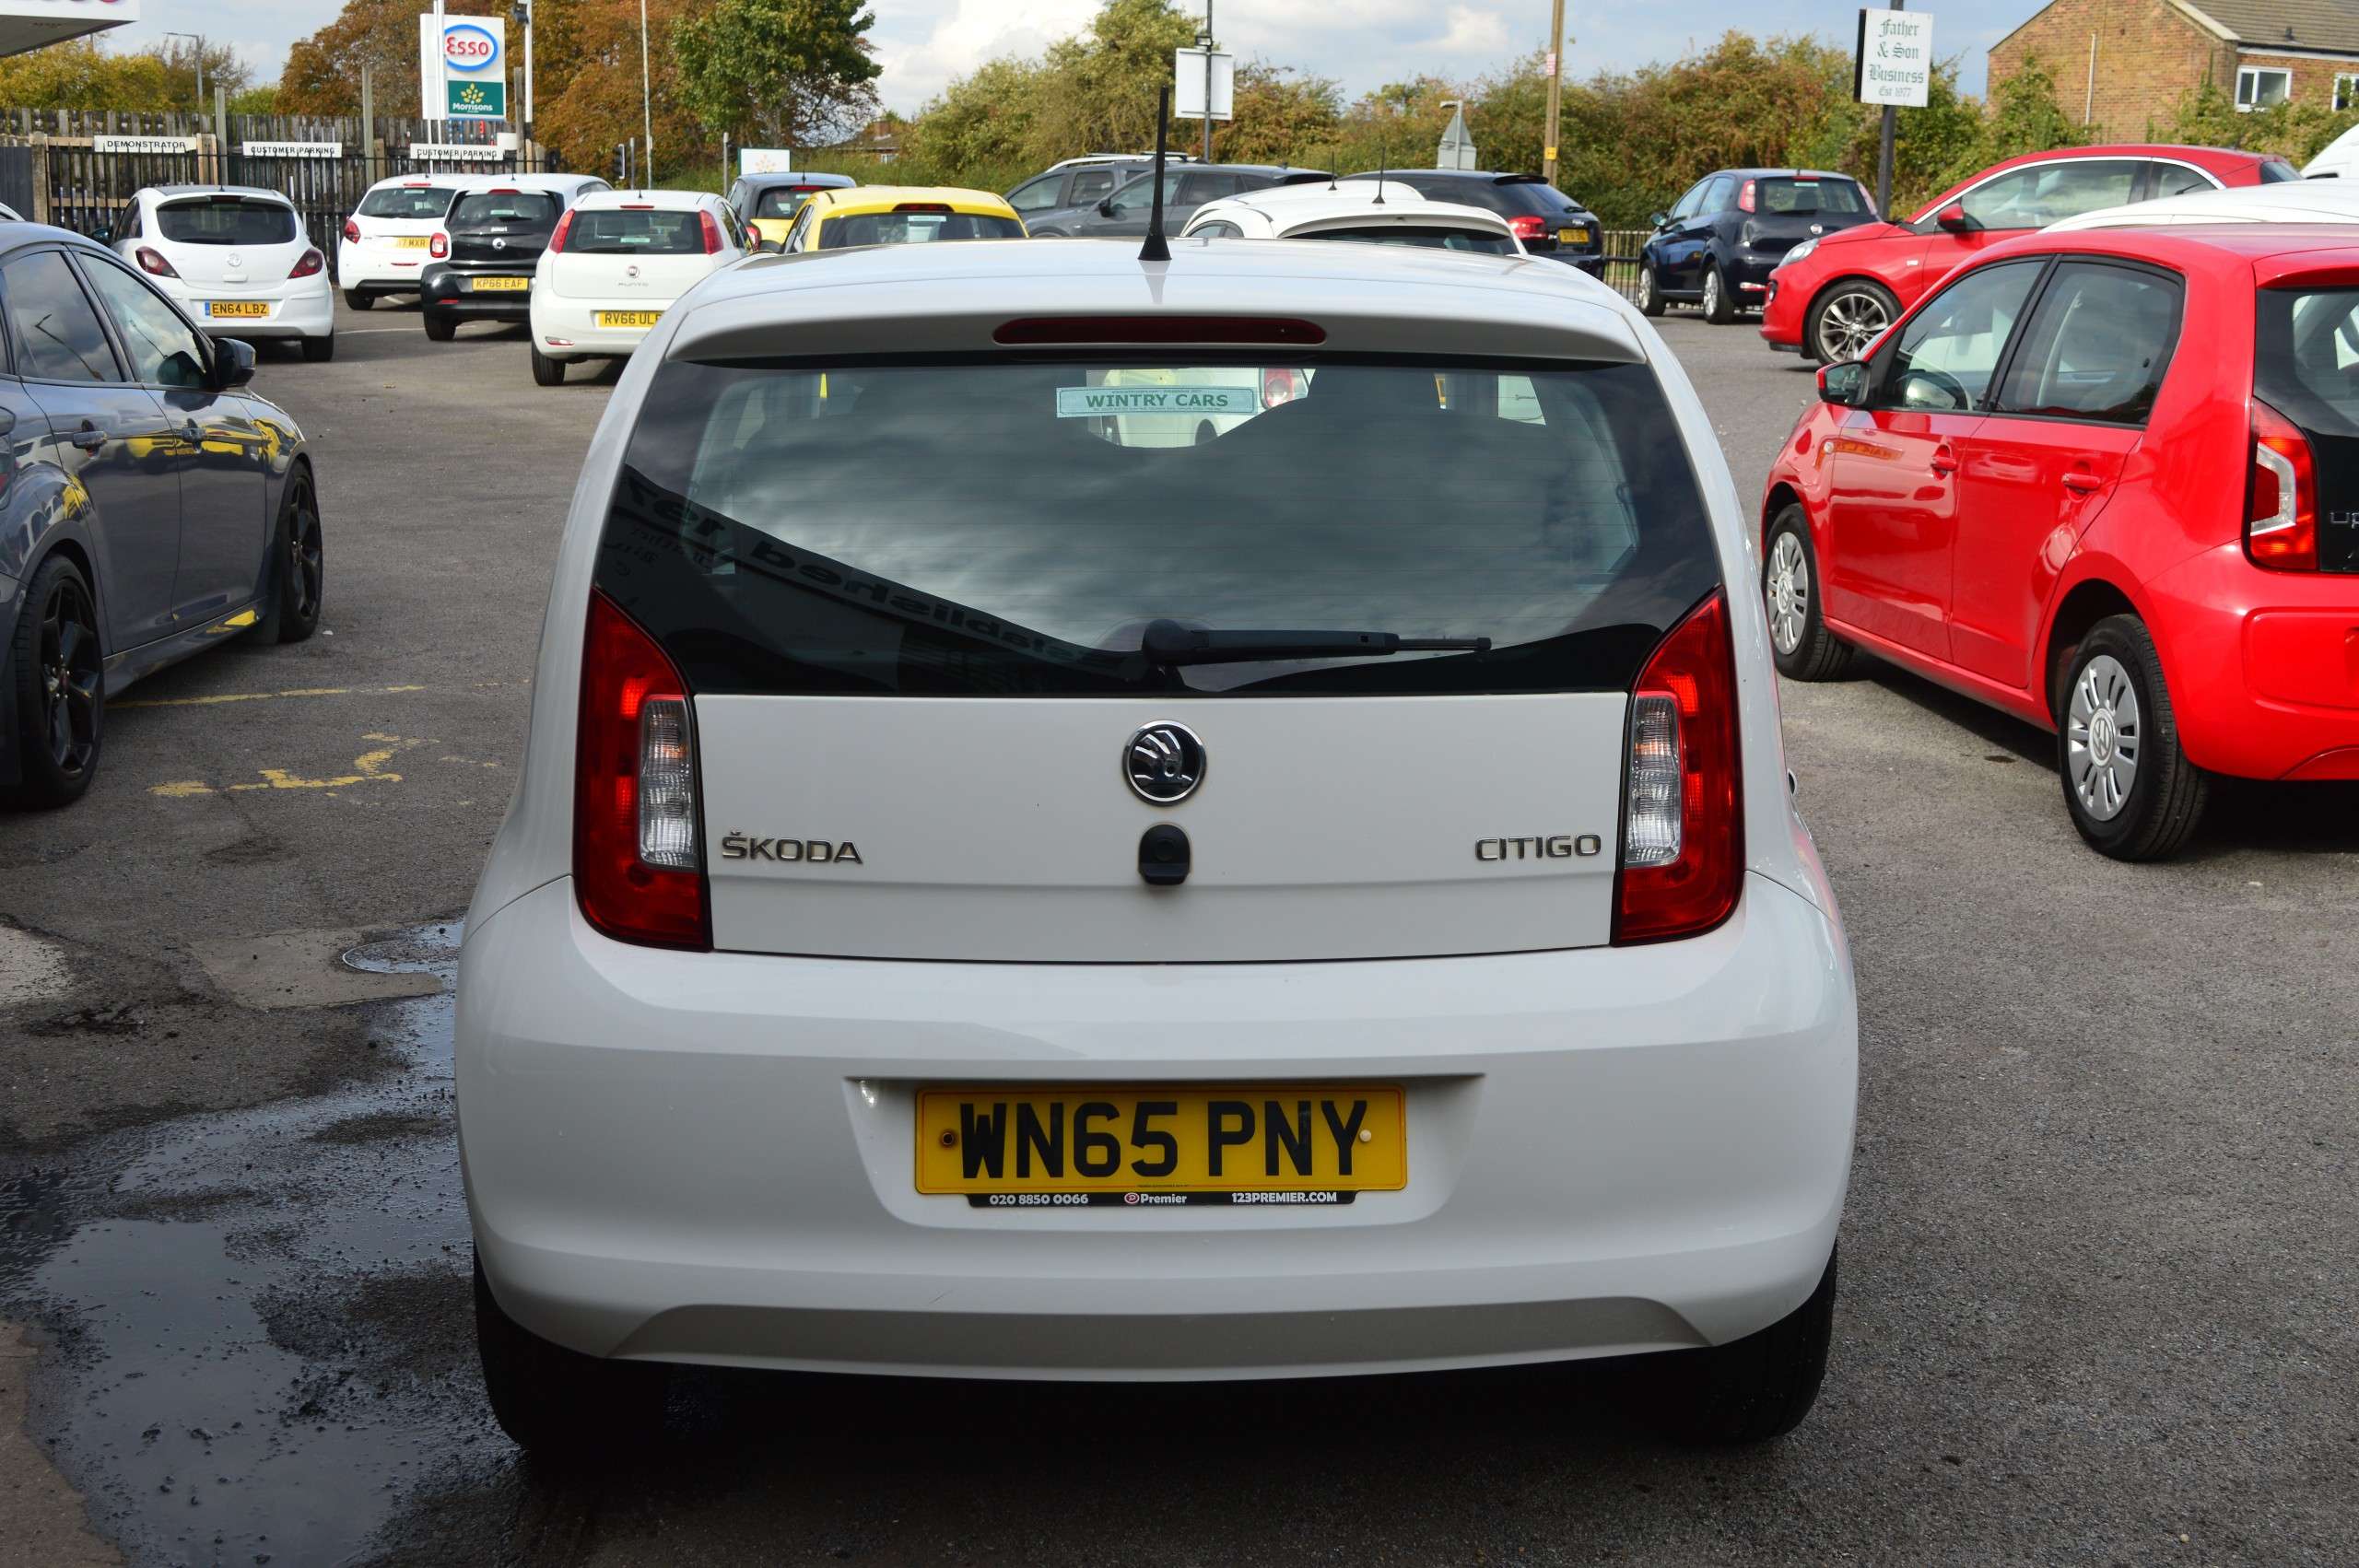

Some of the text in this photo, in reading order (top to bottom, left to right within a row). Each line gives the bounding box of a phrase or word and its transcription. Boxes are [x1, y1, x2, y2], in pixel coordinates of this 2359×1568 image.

[1878, 18, 1919, 38] Father
[446, 36, 489, 55] Esso
[1877, 41, 1919, 59] & Son
[1868, 64, 1924, 83] Business
[452, 102, 493, 111] Morrisons
[107, 140, 185, 148] DEMONSTRATOR
[211, 303, 267, 315] EN64 LBZ
[604, 312, 636, 325] RV66
[1086, 393, 1228, 408] WINTRY CARS
[722, 831, 863, 865] ŠKODA
[1475, 833, 1602, 861] CITIGO
[959, 1099, 1368, 1179] WN65 PNY
[989, 1194, 1089, 1205] 020 8850 0066
[1140, 1193, 1188, 1204] Premier
[1231, 1191, 1337, 1203] 123PREMIER.COM
